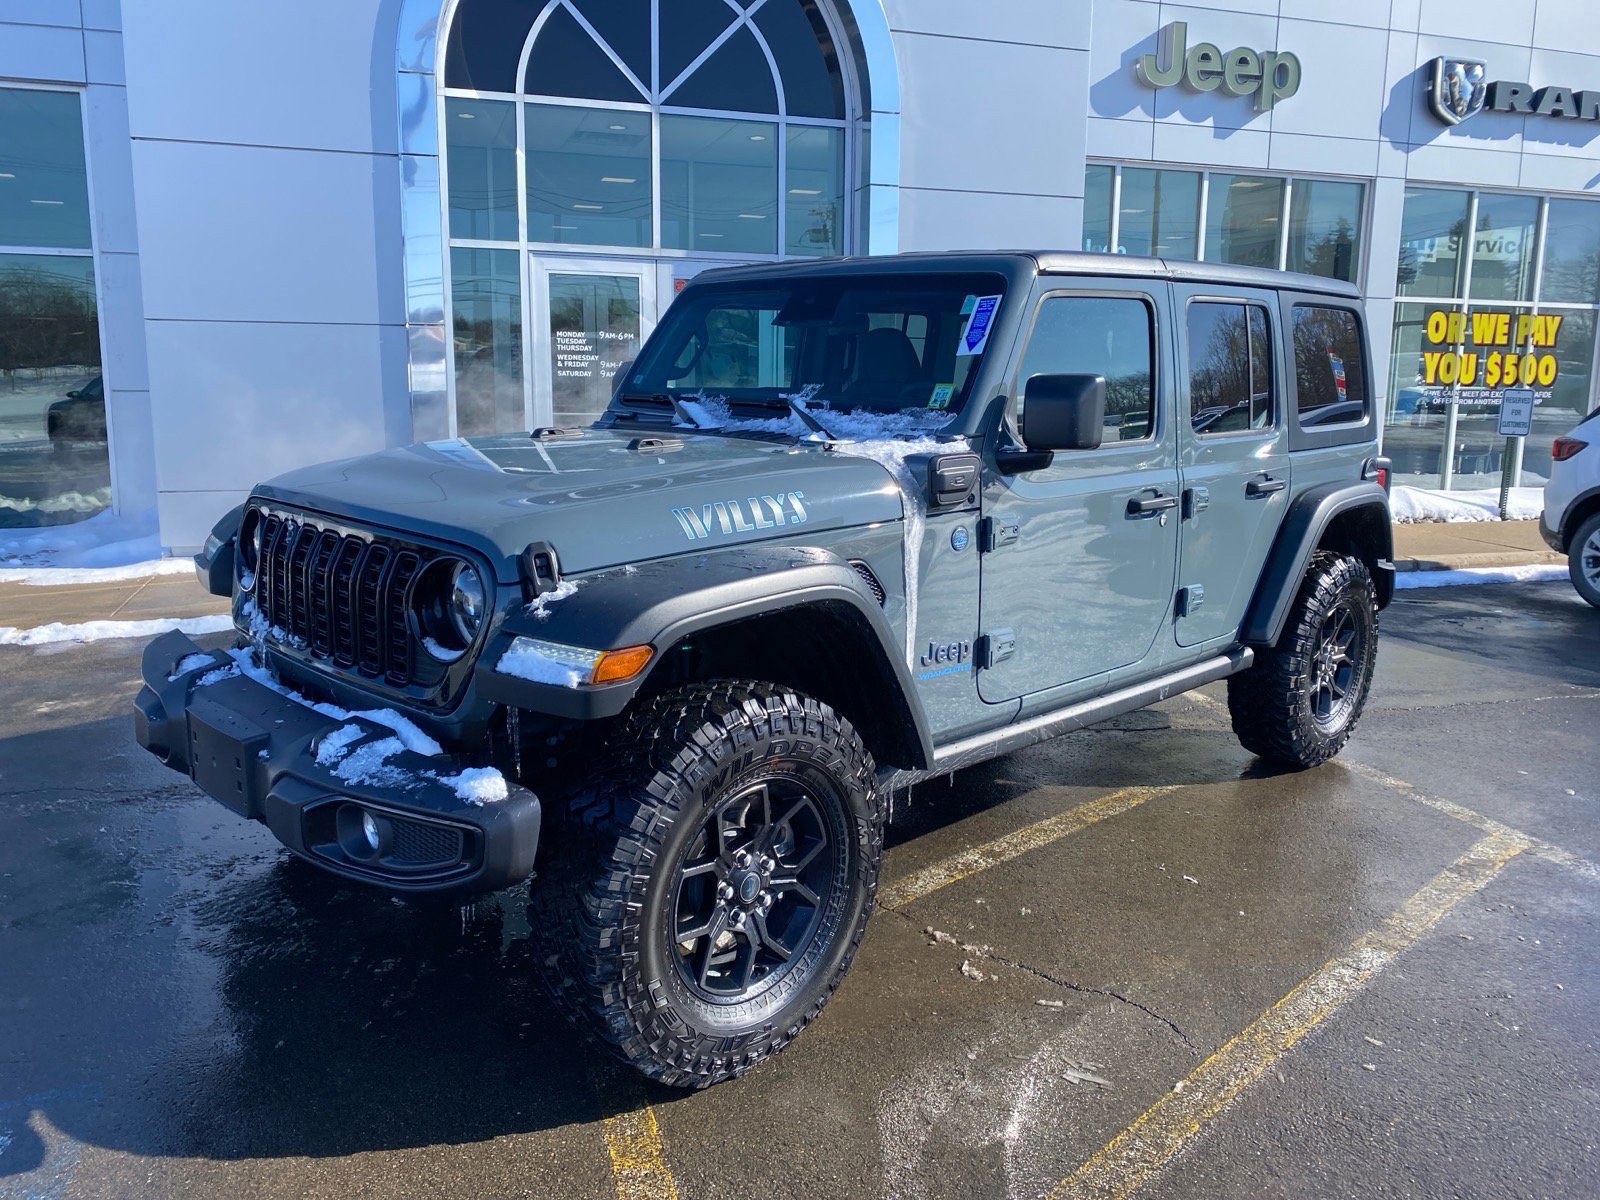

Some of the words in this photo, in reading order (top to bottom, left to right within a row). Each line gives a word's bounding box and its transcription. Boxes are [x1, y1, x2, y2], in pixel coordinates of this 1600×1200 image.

[1136, 21, 1303, 111] Jeep
[1447, 233, 1521, 255] Srvic
[556, 331, 585, 339] MONDAY
[1426, 310, 1467, 346] OR
[1471, 311, 1511, 347] WE
[1516, 313, 1563, 348] PAY
[600, 370, 616, 378] 9AM
[1423, 351, 1477, 387] YOU
[1485, 351, 1559, 388] $500
[672, 491, 808, 540] WILLYS
[920, 639, 970, 667] Jeep
[702, 739, 861, 807] WILDPEAK
